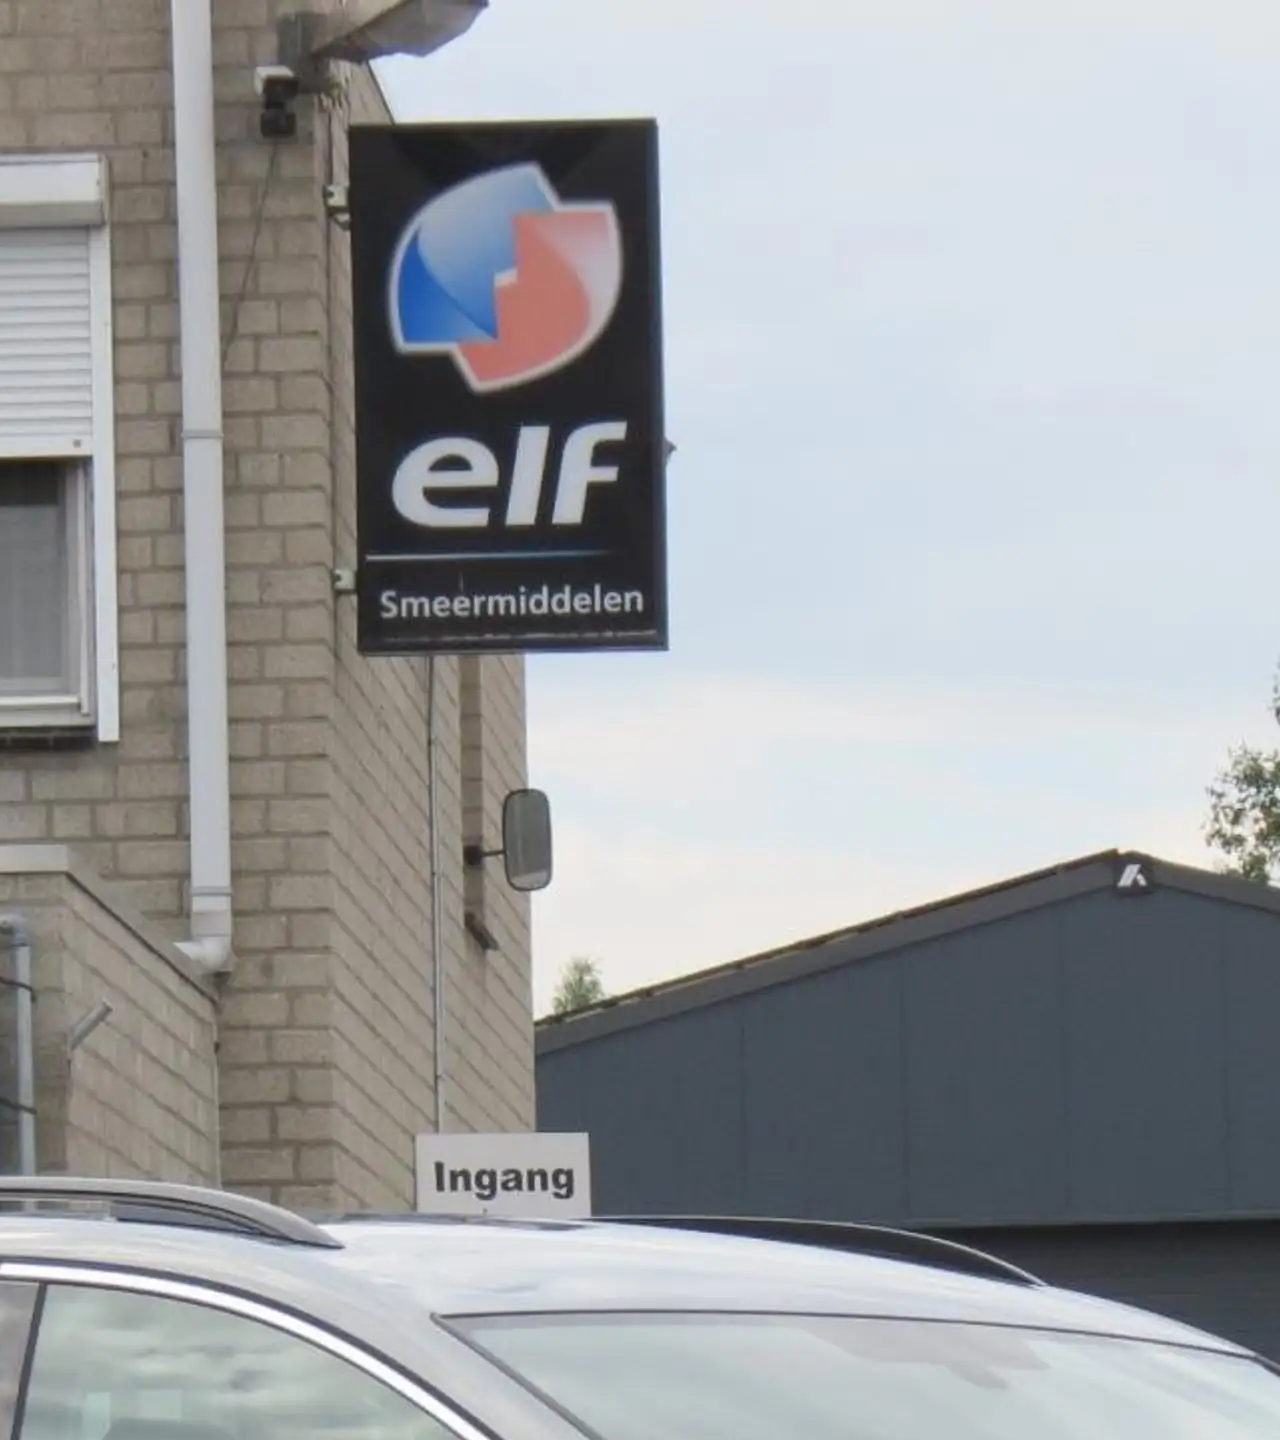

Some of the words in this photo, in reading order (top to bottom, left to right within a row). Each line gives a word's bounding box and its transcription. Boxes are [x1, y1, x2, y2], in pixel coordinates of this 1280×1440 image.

[391, 421, 627, 527] elf
[380, 584, 644, 619] Smeermiddelen
[434, 1161, 574, 1200] Ingang
